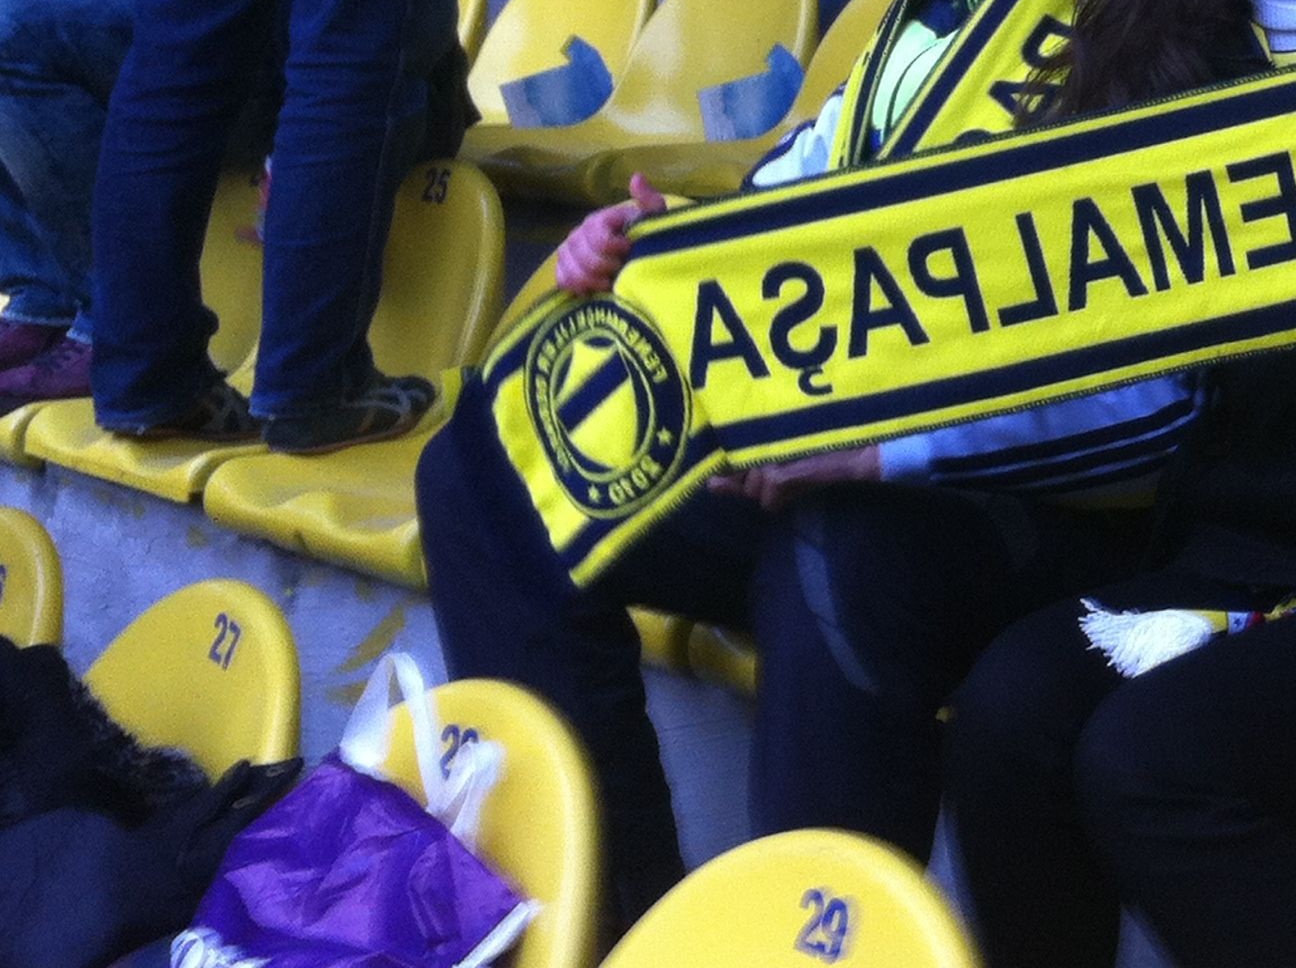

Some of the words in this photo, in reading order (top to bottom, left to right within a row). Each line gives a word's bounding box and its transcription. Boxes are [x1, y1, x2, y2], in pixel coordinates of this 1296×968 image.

[421, 167, 451, 205] 25
[207, 611, 242, 671] 27
[796, 887, 849, 964] 29
